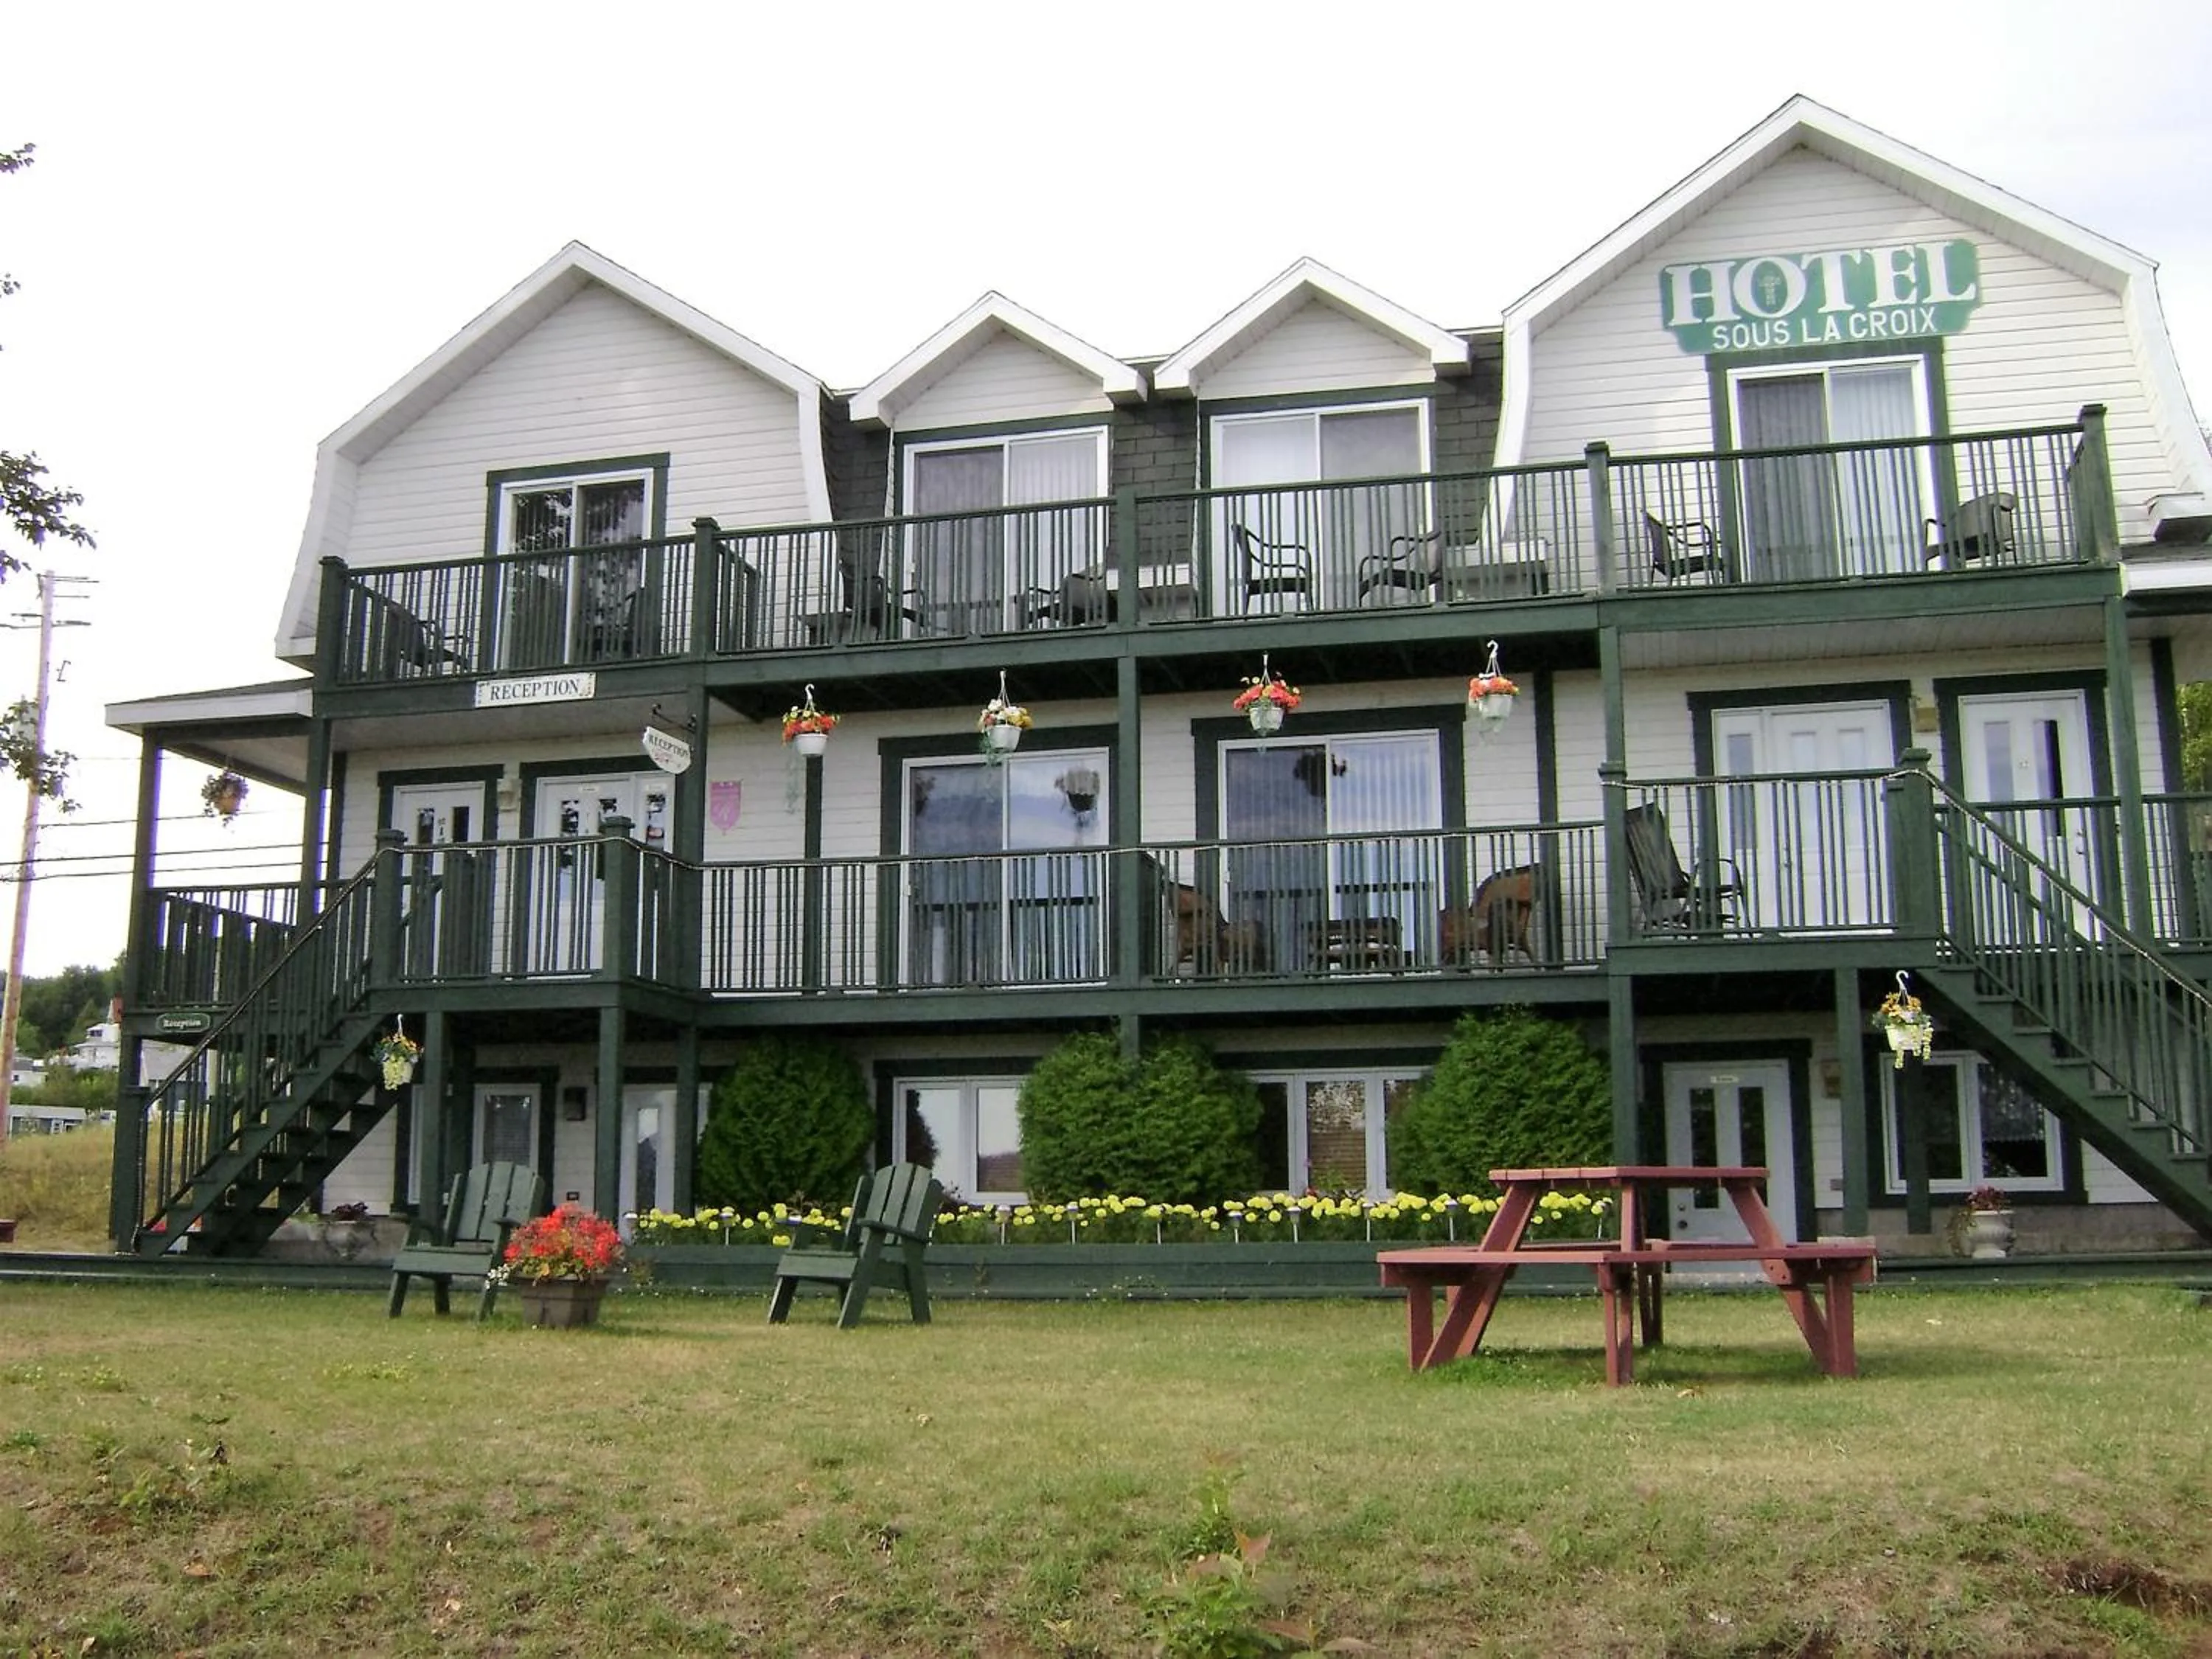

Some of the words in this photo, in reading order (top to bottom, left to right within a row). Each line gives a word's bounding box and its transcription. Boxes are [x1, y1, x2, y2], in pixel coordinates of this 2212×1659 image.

[1666, 241, 1976, 326] HOTEL
[1712, 320, 1791, 349] SOUS
[1802, 316, 1841, 343] LA
[1849, 307, 1938, 336] CROIX
[490, 678, 580, 700] RECEPTION
[648, 734, 689, 757] RECEPTION
